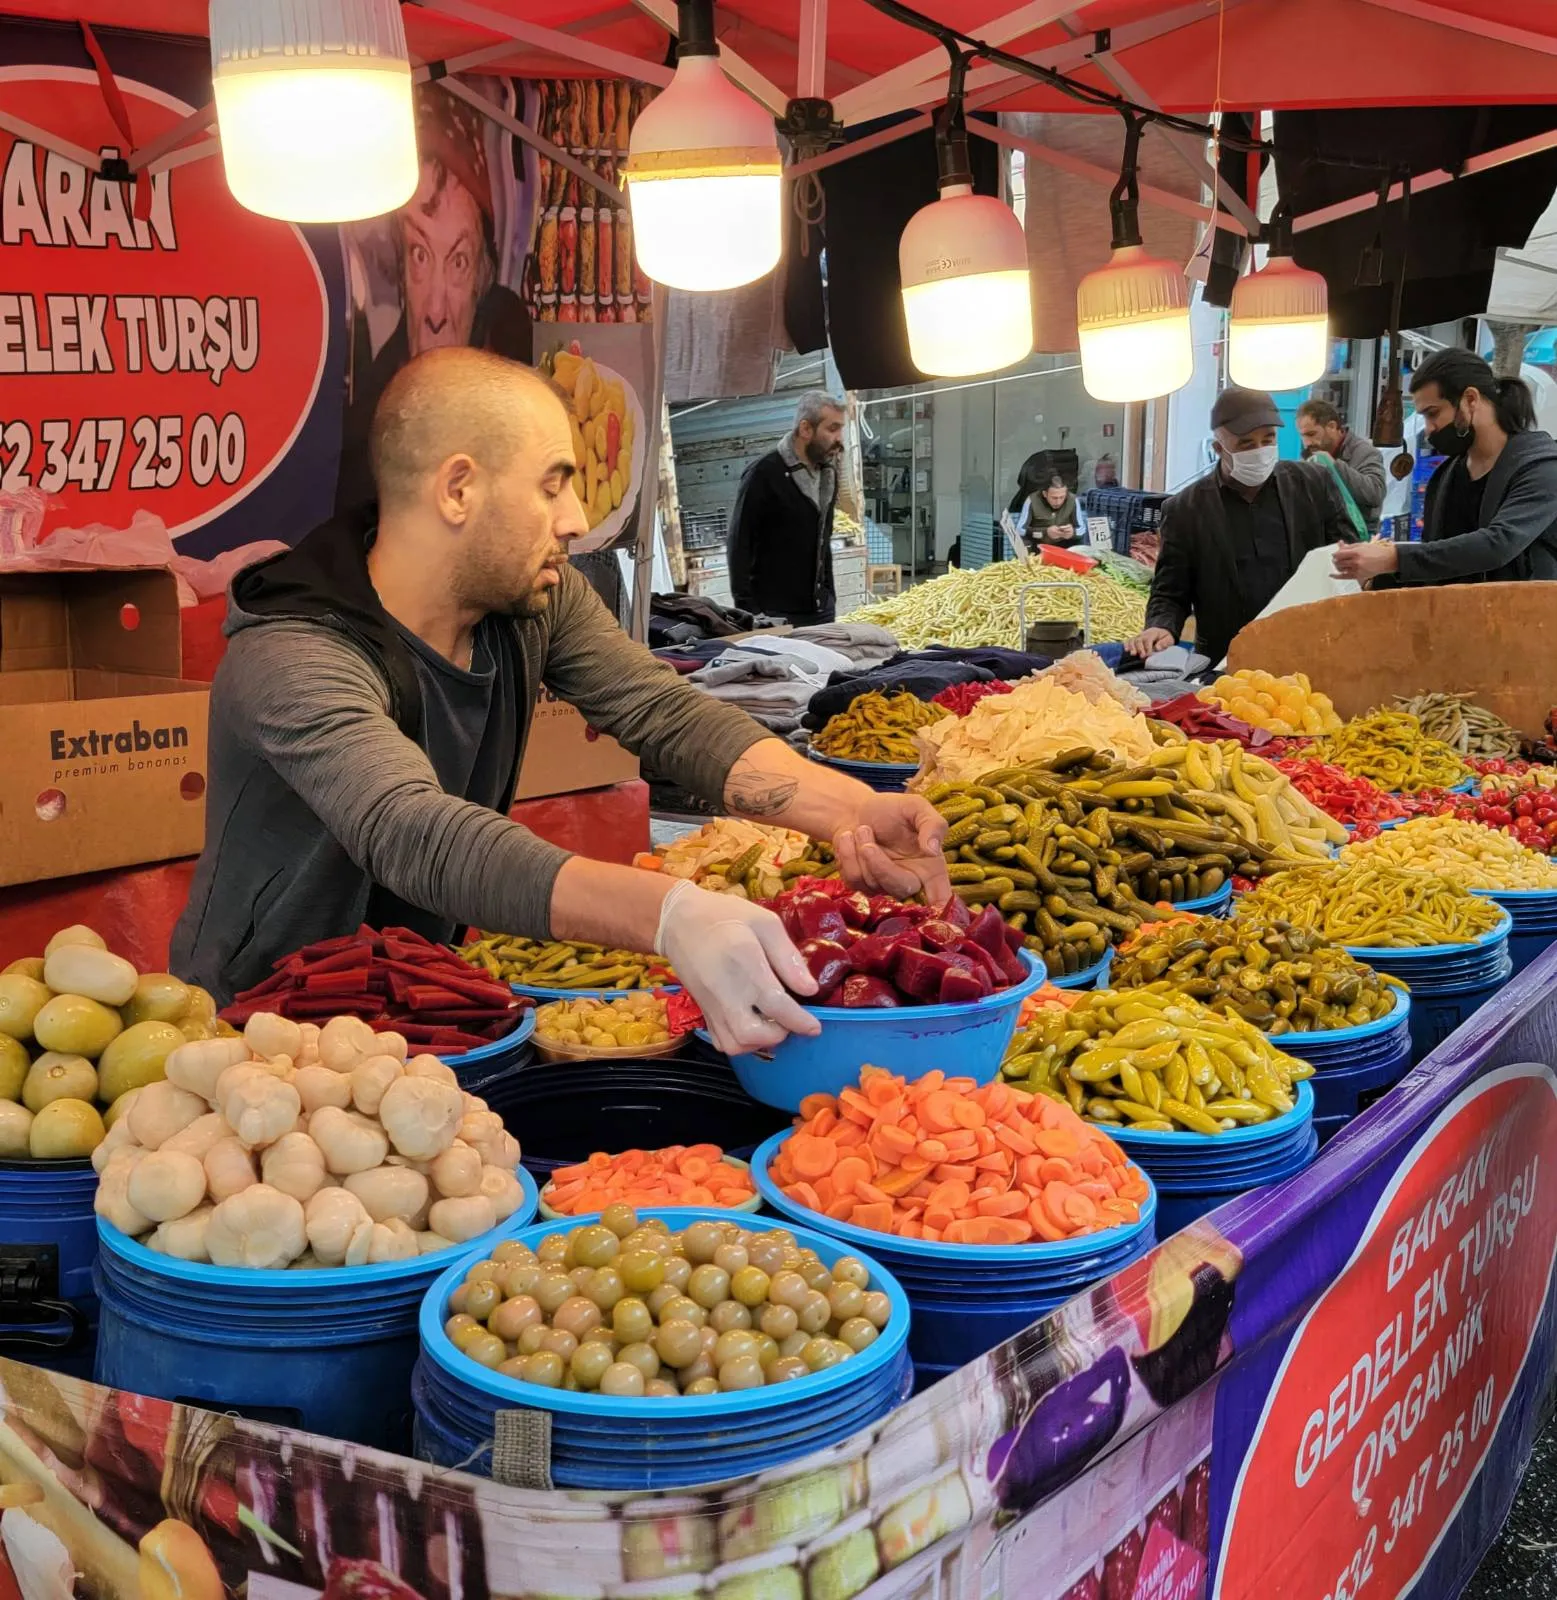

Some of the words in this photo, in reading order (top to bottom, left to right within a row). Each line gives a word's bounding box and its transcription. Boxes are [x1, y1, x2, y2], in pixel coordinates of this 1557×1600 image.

[2, 140, 178, 250] ARAN
[0, 292, 114, 376] ELEK
[115, 296, 259, 385] TURŞU
[0, 418, 34, 494] 2
[38, 418, 125, 495] 347
[129, 414, 183, 489] 25
[189, 412, 247, 486] 00
[50, 720, 189, 761] Extraban
[54, 762, 119, 782] premium
[128, 755, 187, 771] bananas
[1386, 1142, 1497, 1293] BARAN
[1294, 1251, 1453, 1488] GEDELEK
[1458, 1154, 1540, 1289] TURŞU
[1323, 1524, 1378, 1600] 532
[1383, 1452, 1432, 1554] 347
[1436, 1409, 1466, 1491] 25
[1471, 1375, 1495, 1447] 00
